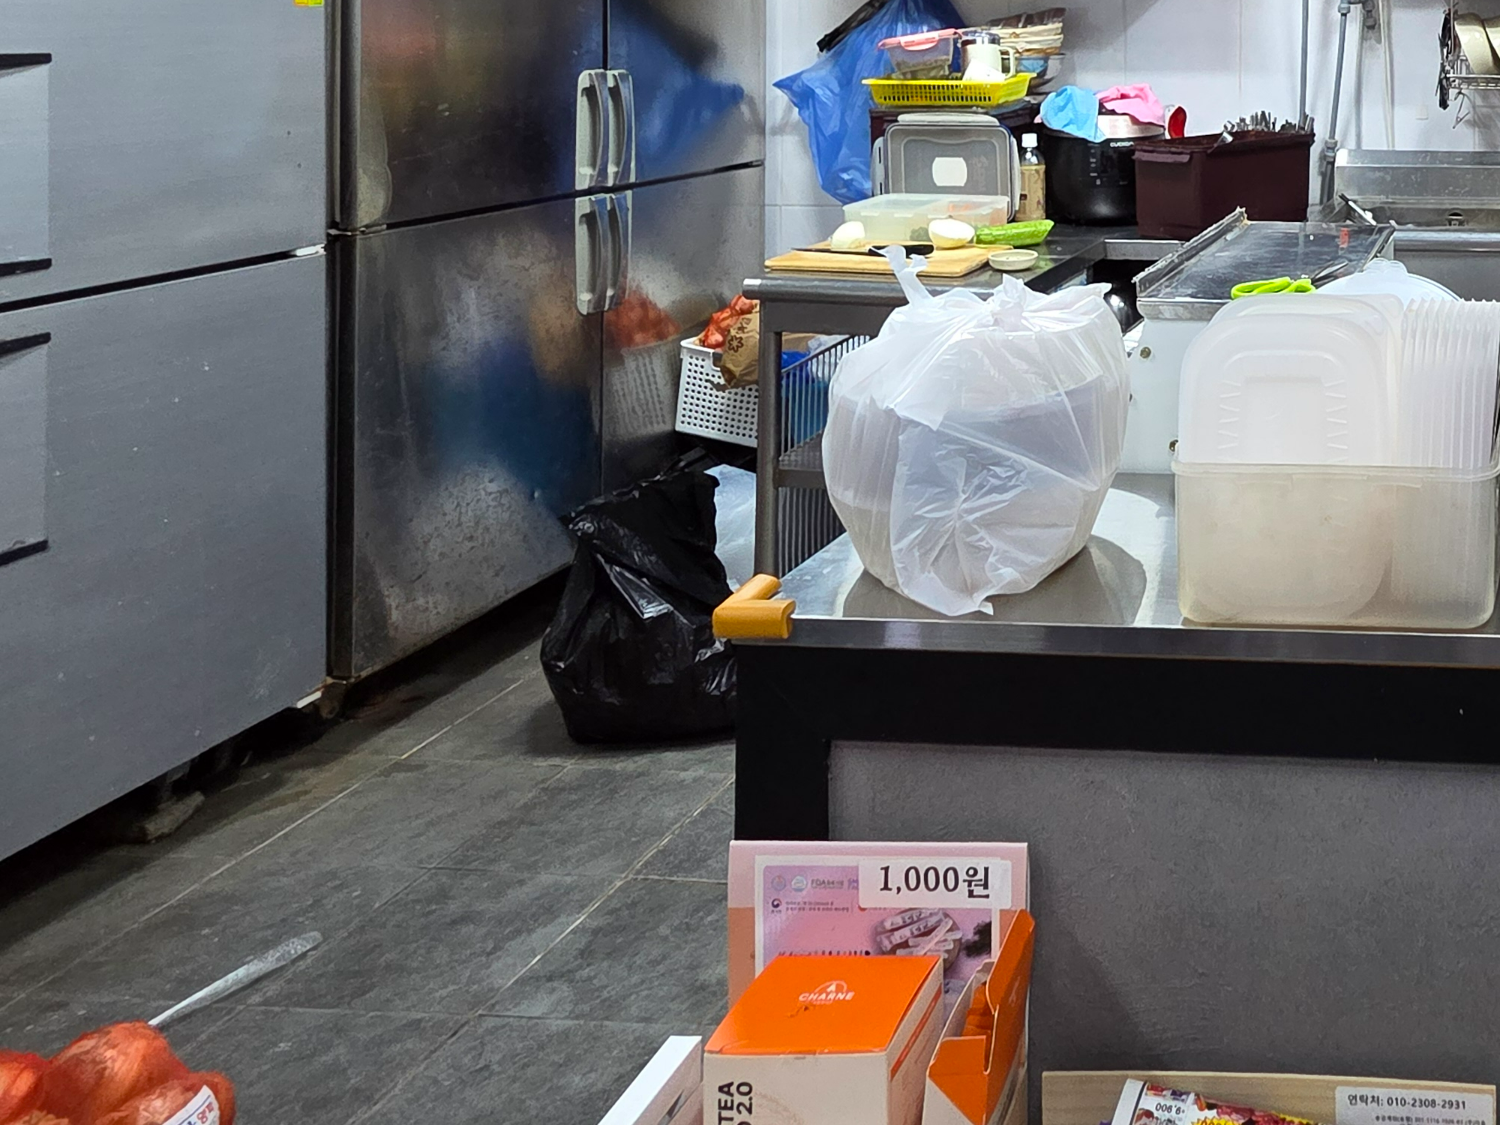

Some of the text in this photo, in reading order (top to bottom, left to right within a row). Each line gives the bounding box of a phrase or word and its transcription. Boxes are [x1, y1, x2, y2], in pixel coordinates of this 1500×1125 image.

[879, 865, 990, 899] 1,000원
[1347, 1093, 1467, 1110] 연락처: 010-2308-2931
